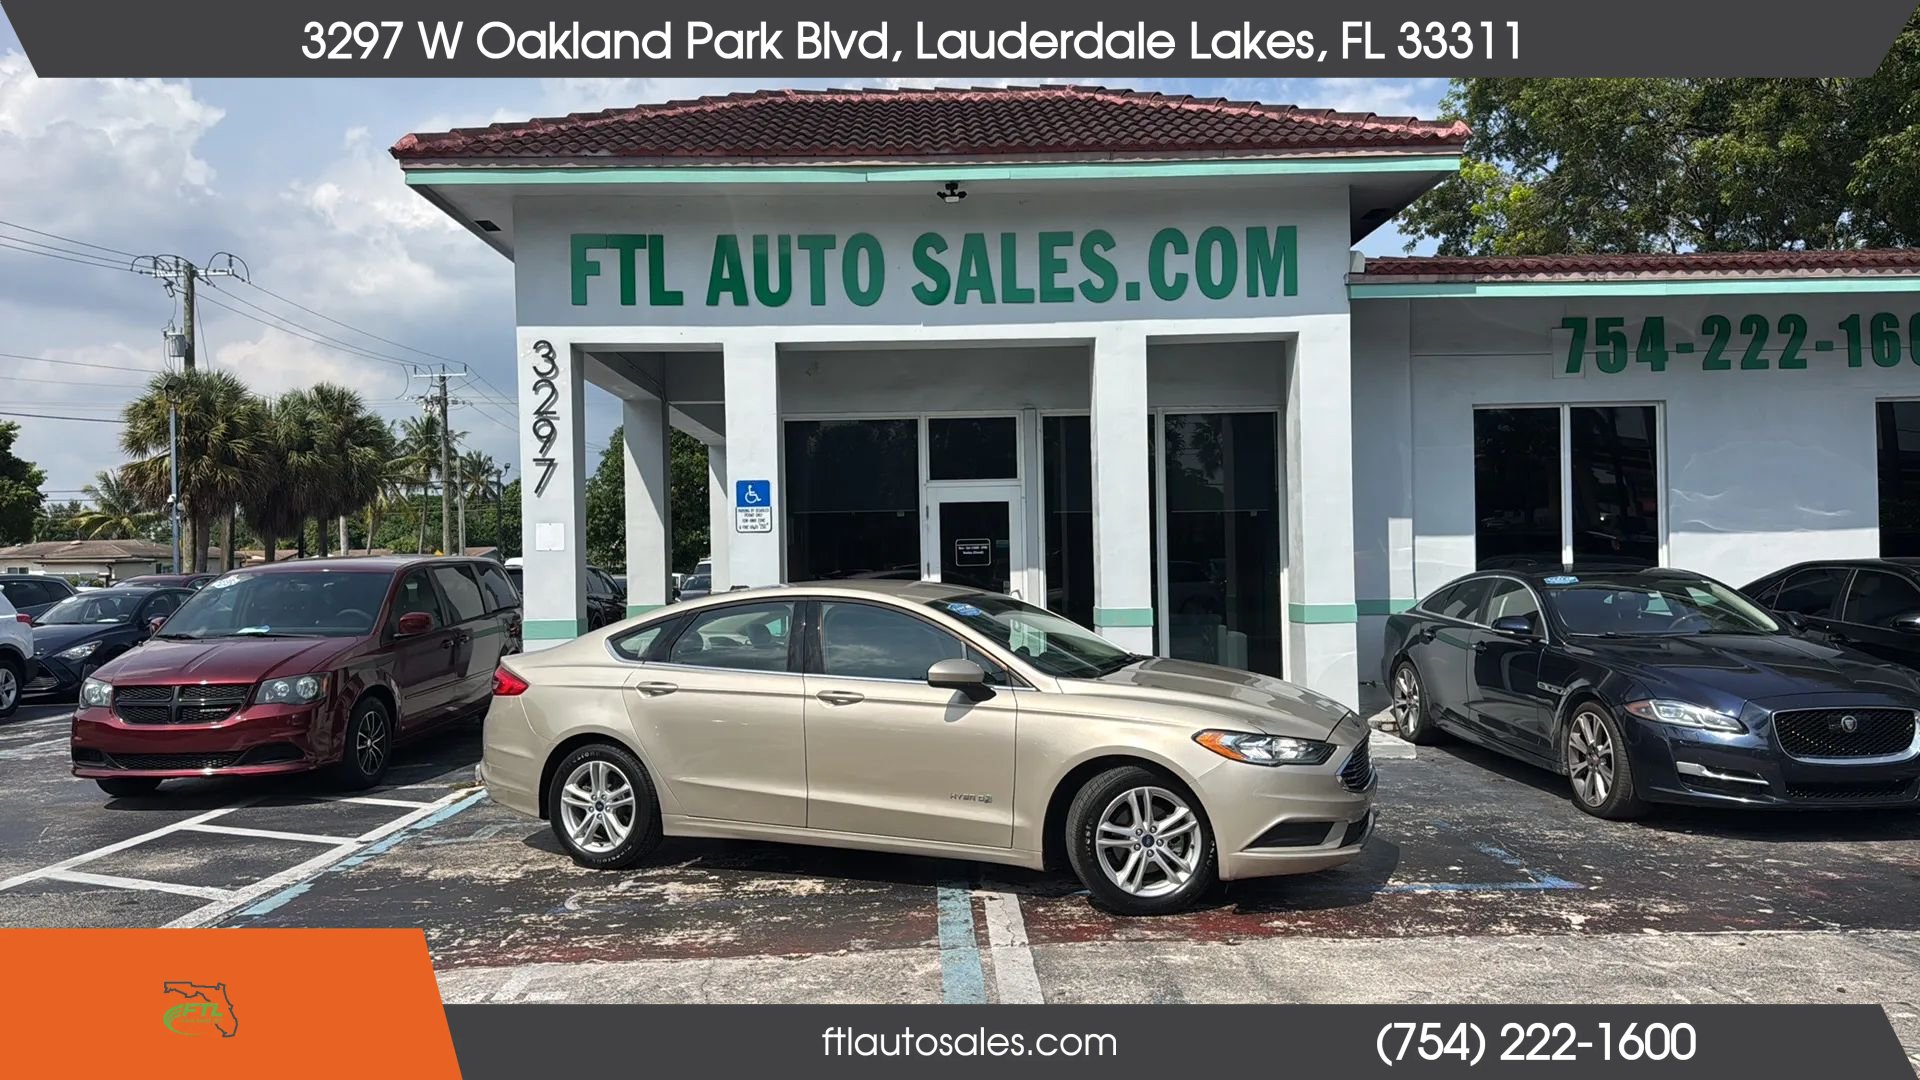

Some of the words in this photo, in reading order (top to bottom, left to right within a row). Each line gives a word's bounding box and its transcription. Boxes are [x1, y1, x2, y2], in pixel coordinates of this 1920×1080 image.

[571, 233, 685, 306] FTL
[706, 231, 885, 307] AUTO
[911, 225, 1299, 306] SALES.COM
[532, 339, 558, 497] 3297
